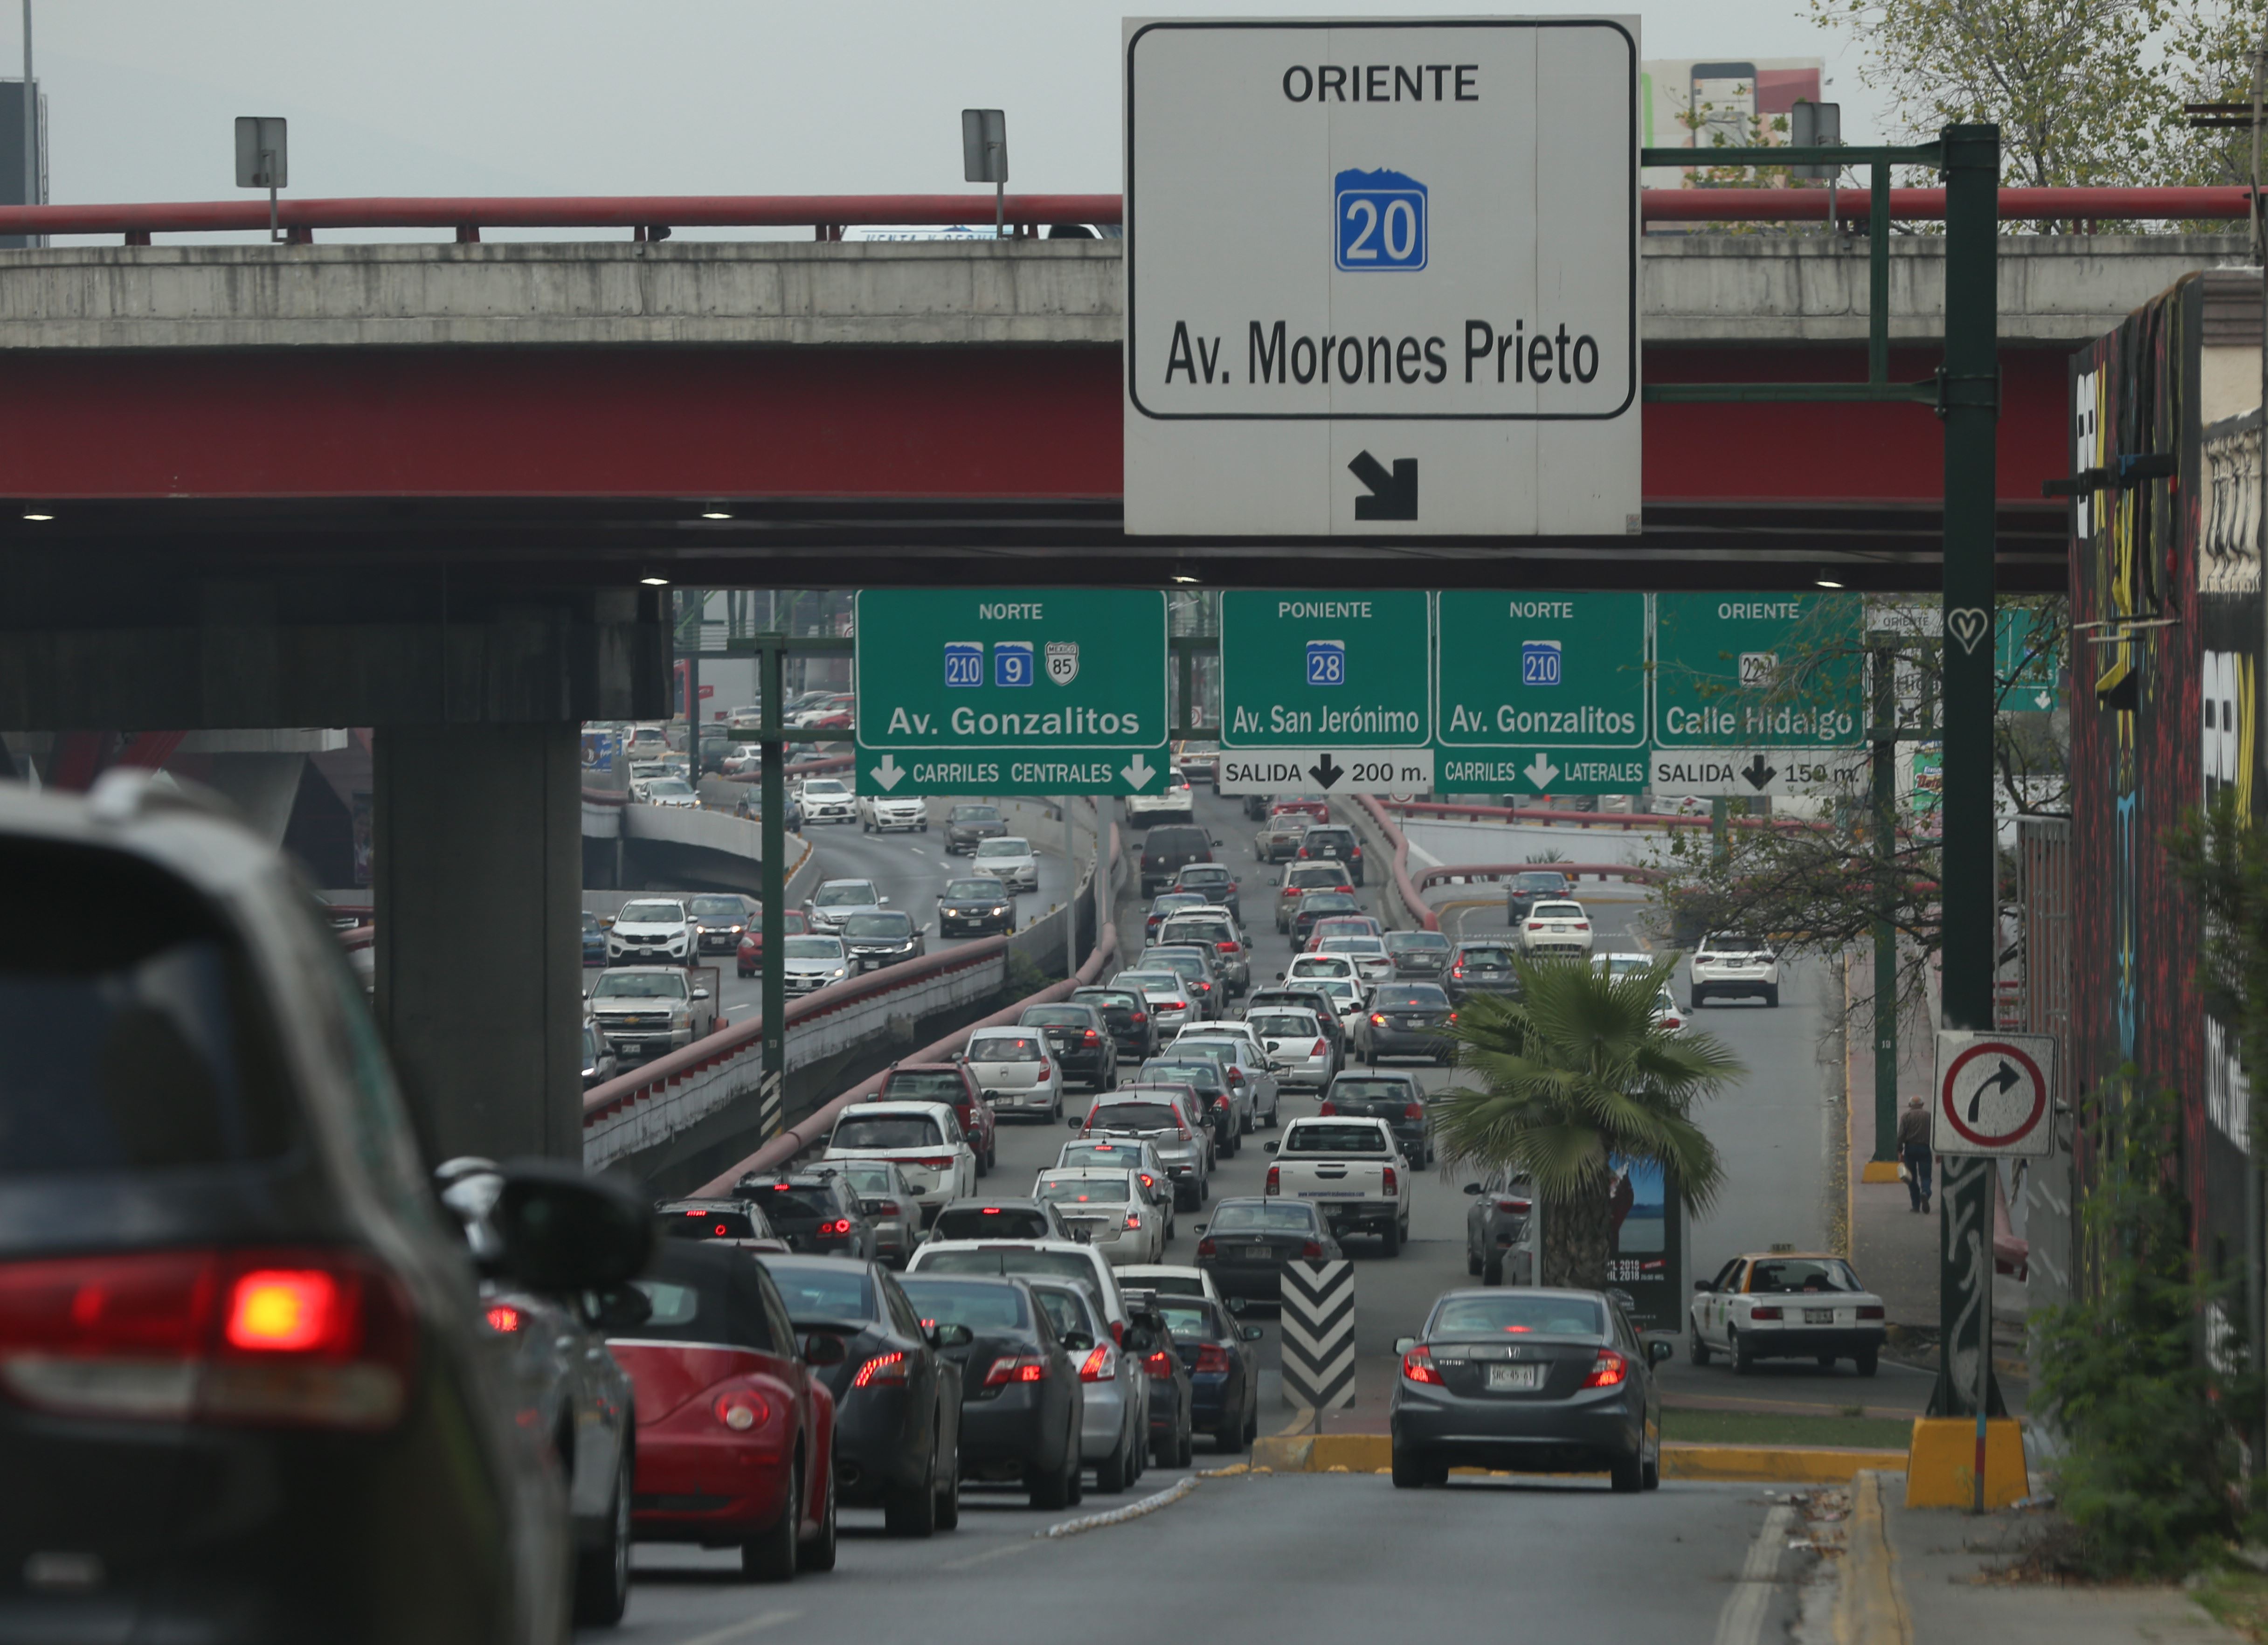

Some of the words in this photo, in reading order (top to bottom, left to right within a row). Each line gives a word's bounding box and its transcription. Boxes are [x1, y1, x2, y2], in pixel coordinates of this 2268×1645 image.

[1283, 65, 1479, 102] ORIENTE
[1347, 199, 1416, 260] 20
[1165, 321, 1229, 384] Av.
[1250, 321, 1447, 384] Morones
[1465, 319, 1599, 384] Prieto
[980, 603, 1043, 619] NORTE
[1279, 602, 1372, 618] PONIENTE
[1510, 602, 1573, 618] NORTE
[1718, 603, 1800, 619] ORIENTE
[948, 657, 979, 682] 210
[1005, 657, 1022, 682] 9
[1053, 659, 1072, 675] 85
[1312, 656, 1340, 681] 28
[1526, 656, 1557, 681] 210
[887, 707, 938, 734] Av.
[951, 707, 1140, 735] Gonzalitos
[1232, 706, 1263, 733] Av.
[1270, 705, 1312, 733] San
[1318, 705, 1419, 733] Jerónimo
[1450, 705, 1487, 732] Av.
[1497, 705, 1635, 733] Gonzalitos
[1666, 706, 1736, 734] Calle
[1745, 706, 1853, 740] Hidalgo
[913, 763, 999, 782] CARRILES
[1011, 763, 1113, 783] CENTRALES
[1226, 763, 1302, 781] SALIDA
[1352, 763, 1393, 781] 200
[1401, 767, 1427, 781] m.
[1445, 761, 1515, 781] CARRILES
[1565, 762, 1644, 782] LATERALES
[1658, 764, 1735, 782] SALIDA
[1785, 764, 1827, 782] 150
[1619, 1260, 1639, 1271] 2018
[1619, 1271, 1639, 1281] 2018
